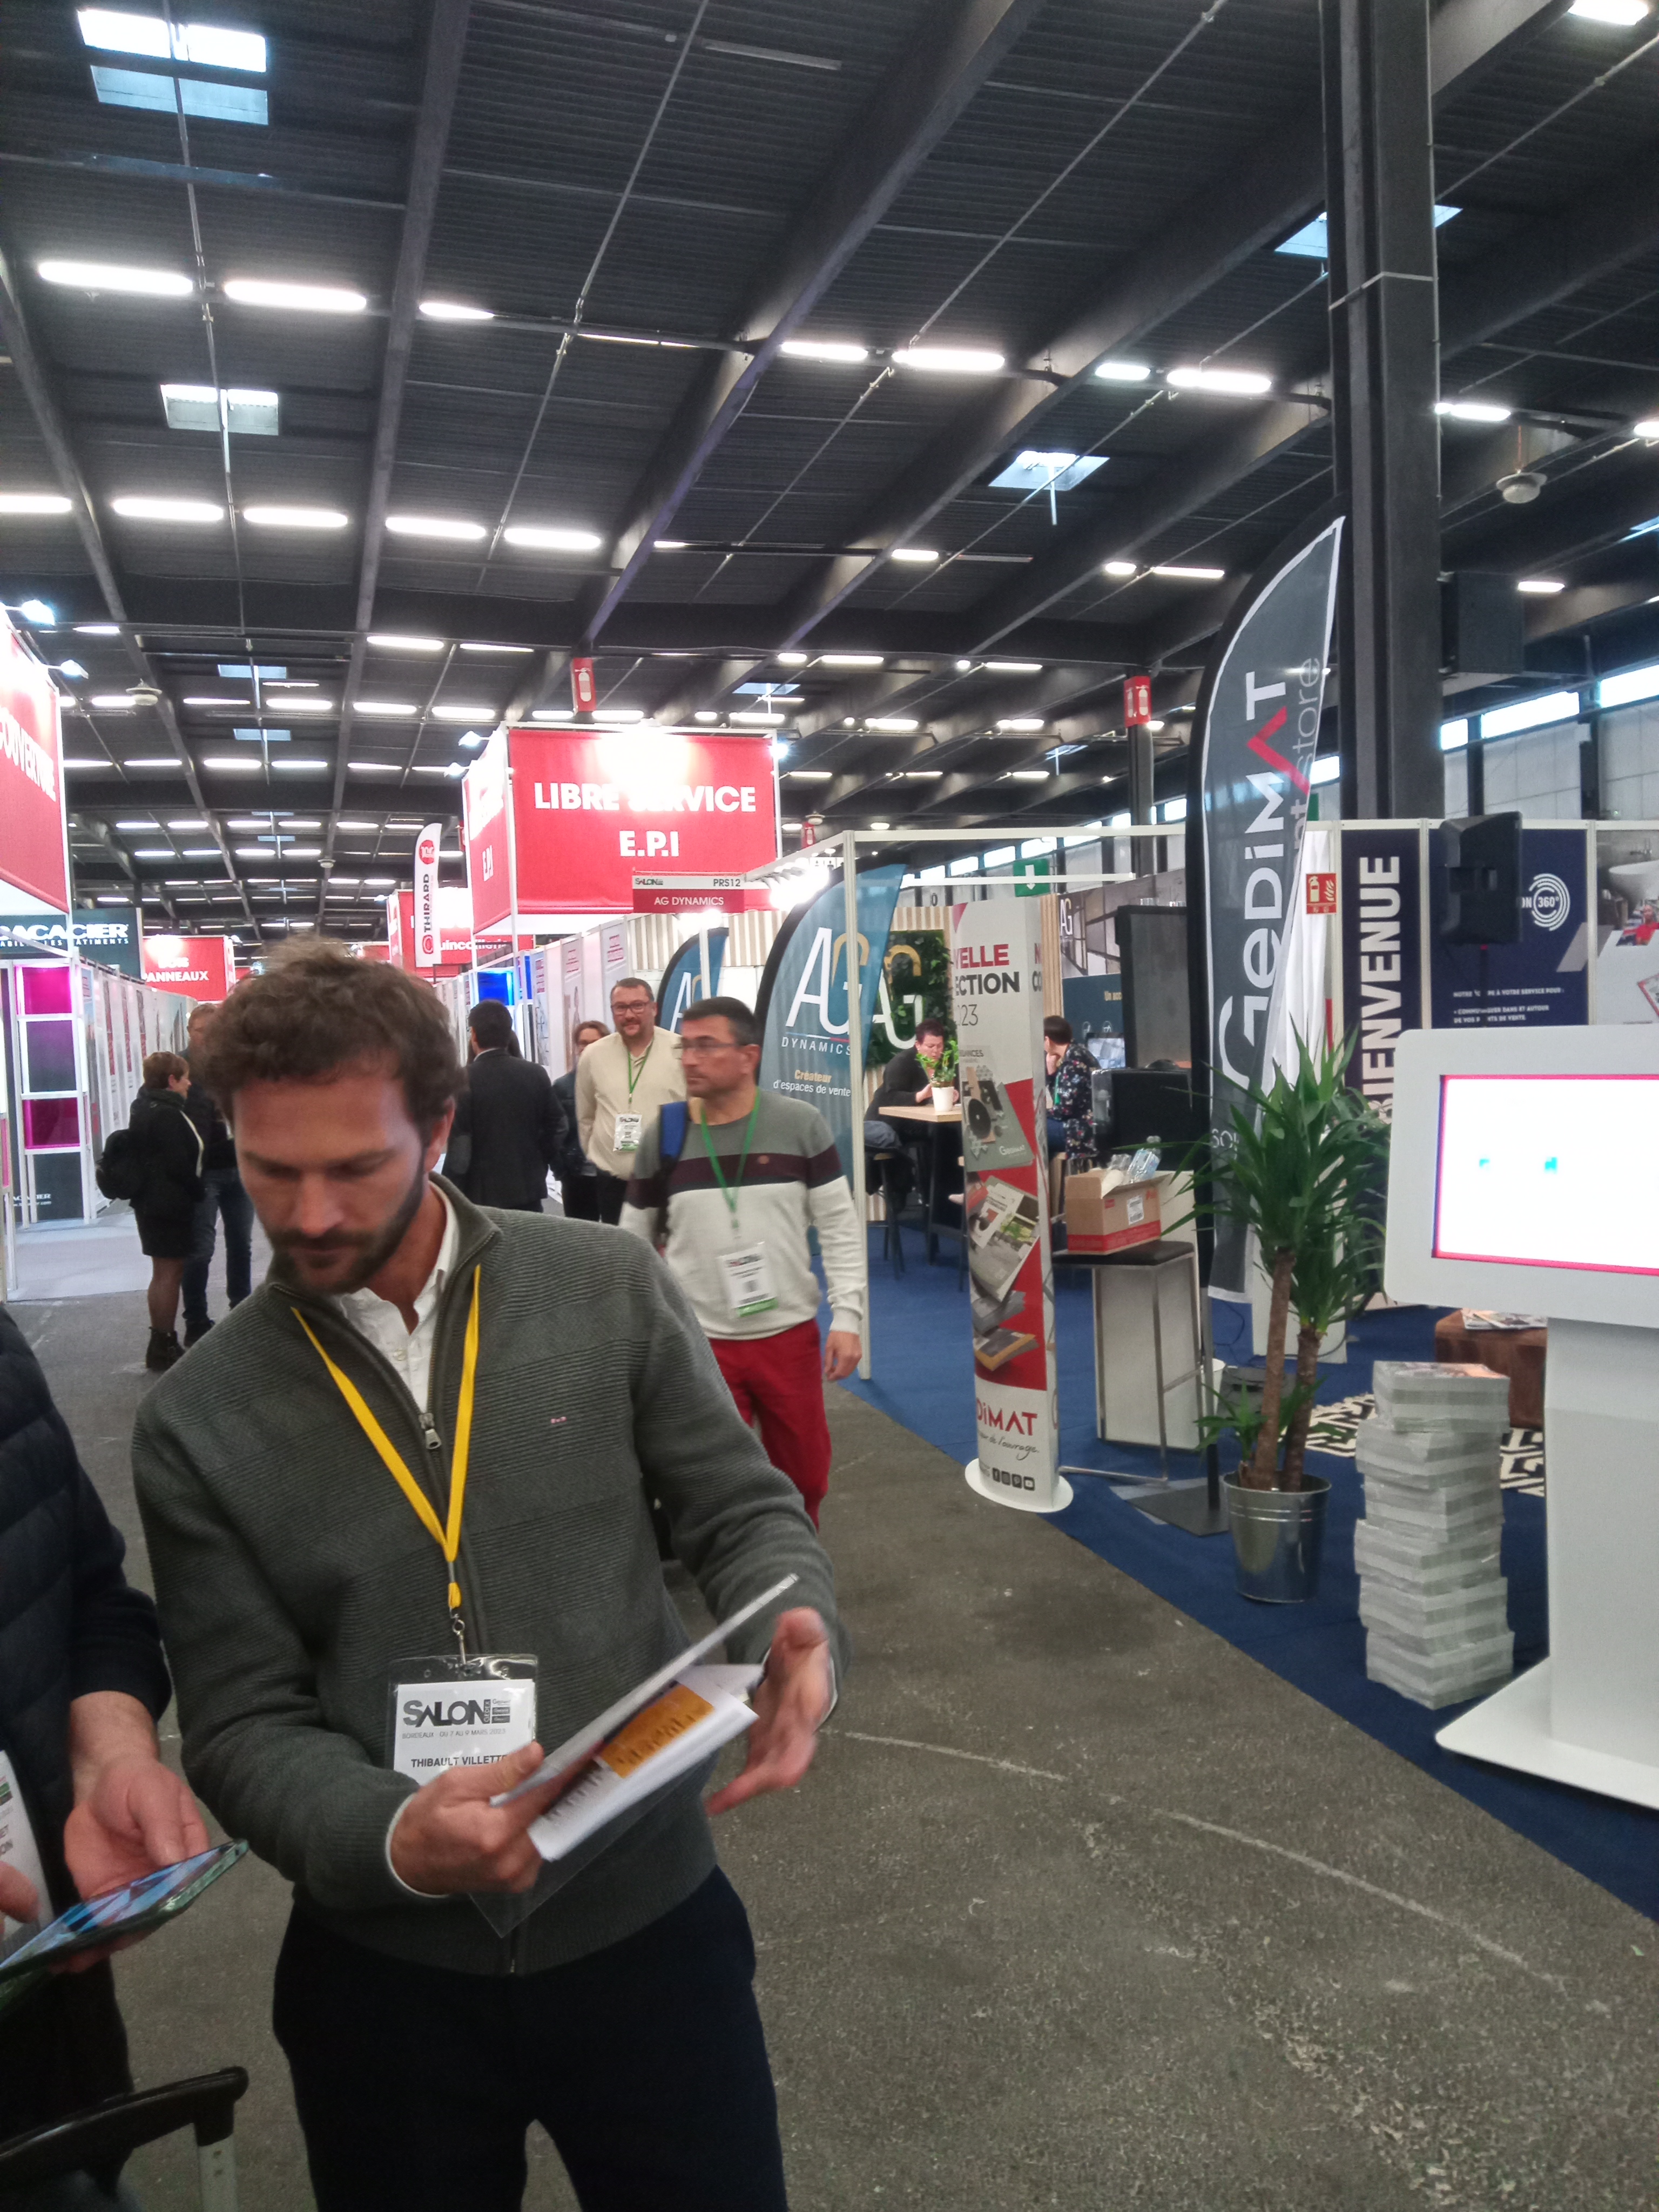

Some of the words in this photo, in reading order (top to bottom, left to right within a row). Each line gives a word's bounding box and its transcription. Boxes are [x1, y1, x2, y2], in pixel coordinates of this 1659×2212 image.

[534, 782, 620, 810] LIBRE
[628, 786, 756, 812] RVICE
[713, 879, 741, 887] PRS12
[654, 897, 670, 906] AG
[672, 896, 724, 906] DYNAMICS
[0, 924, 129, 941] ACACIER
[794, 1069, 832, 1083] Créateur
[773, 1079, 814, 1093] d'espaces
[816, 1084, 826, 1094] de
[828, 1087, 851, 1097] vente
[403, 1700, 486, 1728] SALON
[411, 1757, 460, 1768] THIBAULT
[462, 1755, 508, 1765] VILLETT
